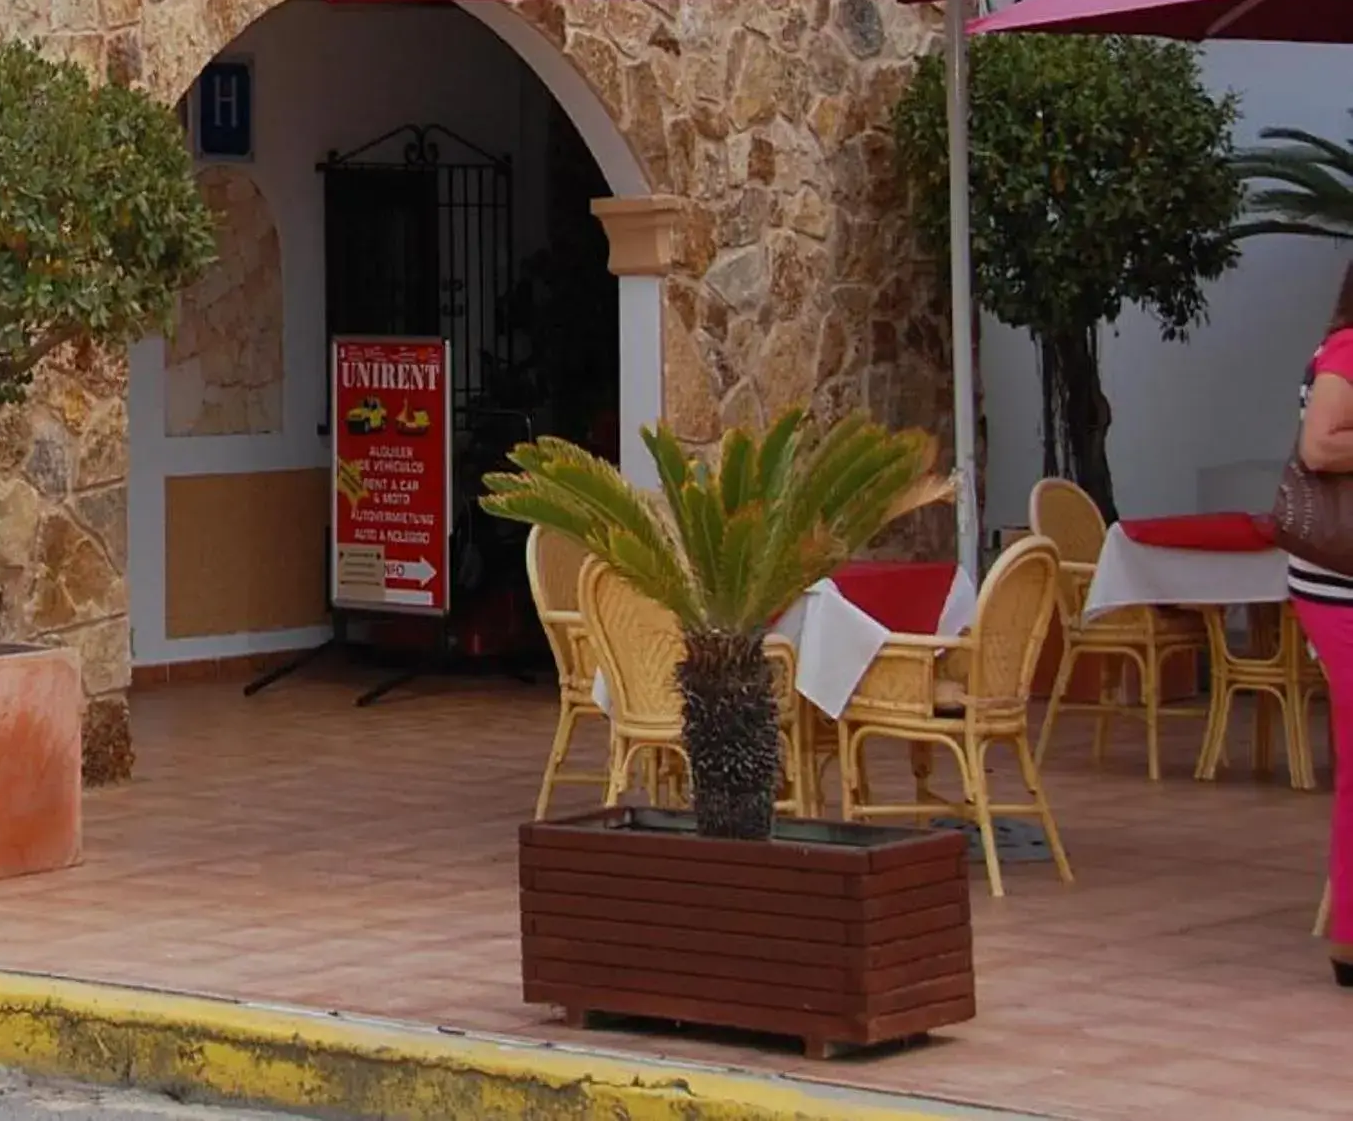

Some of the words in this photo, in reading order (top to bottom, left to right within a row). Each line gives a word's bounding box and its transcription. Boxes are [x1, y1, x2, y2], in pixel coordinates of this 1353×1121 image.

[213, 74, 238, 128] H
[341, 361, 440, 391] UNIRENT
[399, 479, 420, 492] CAR
[382, 493, 411, 505] MOTO
